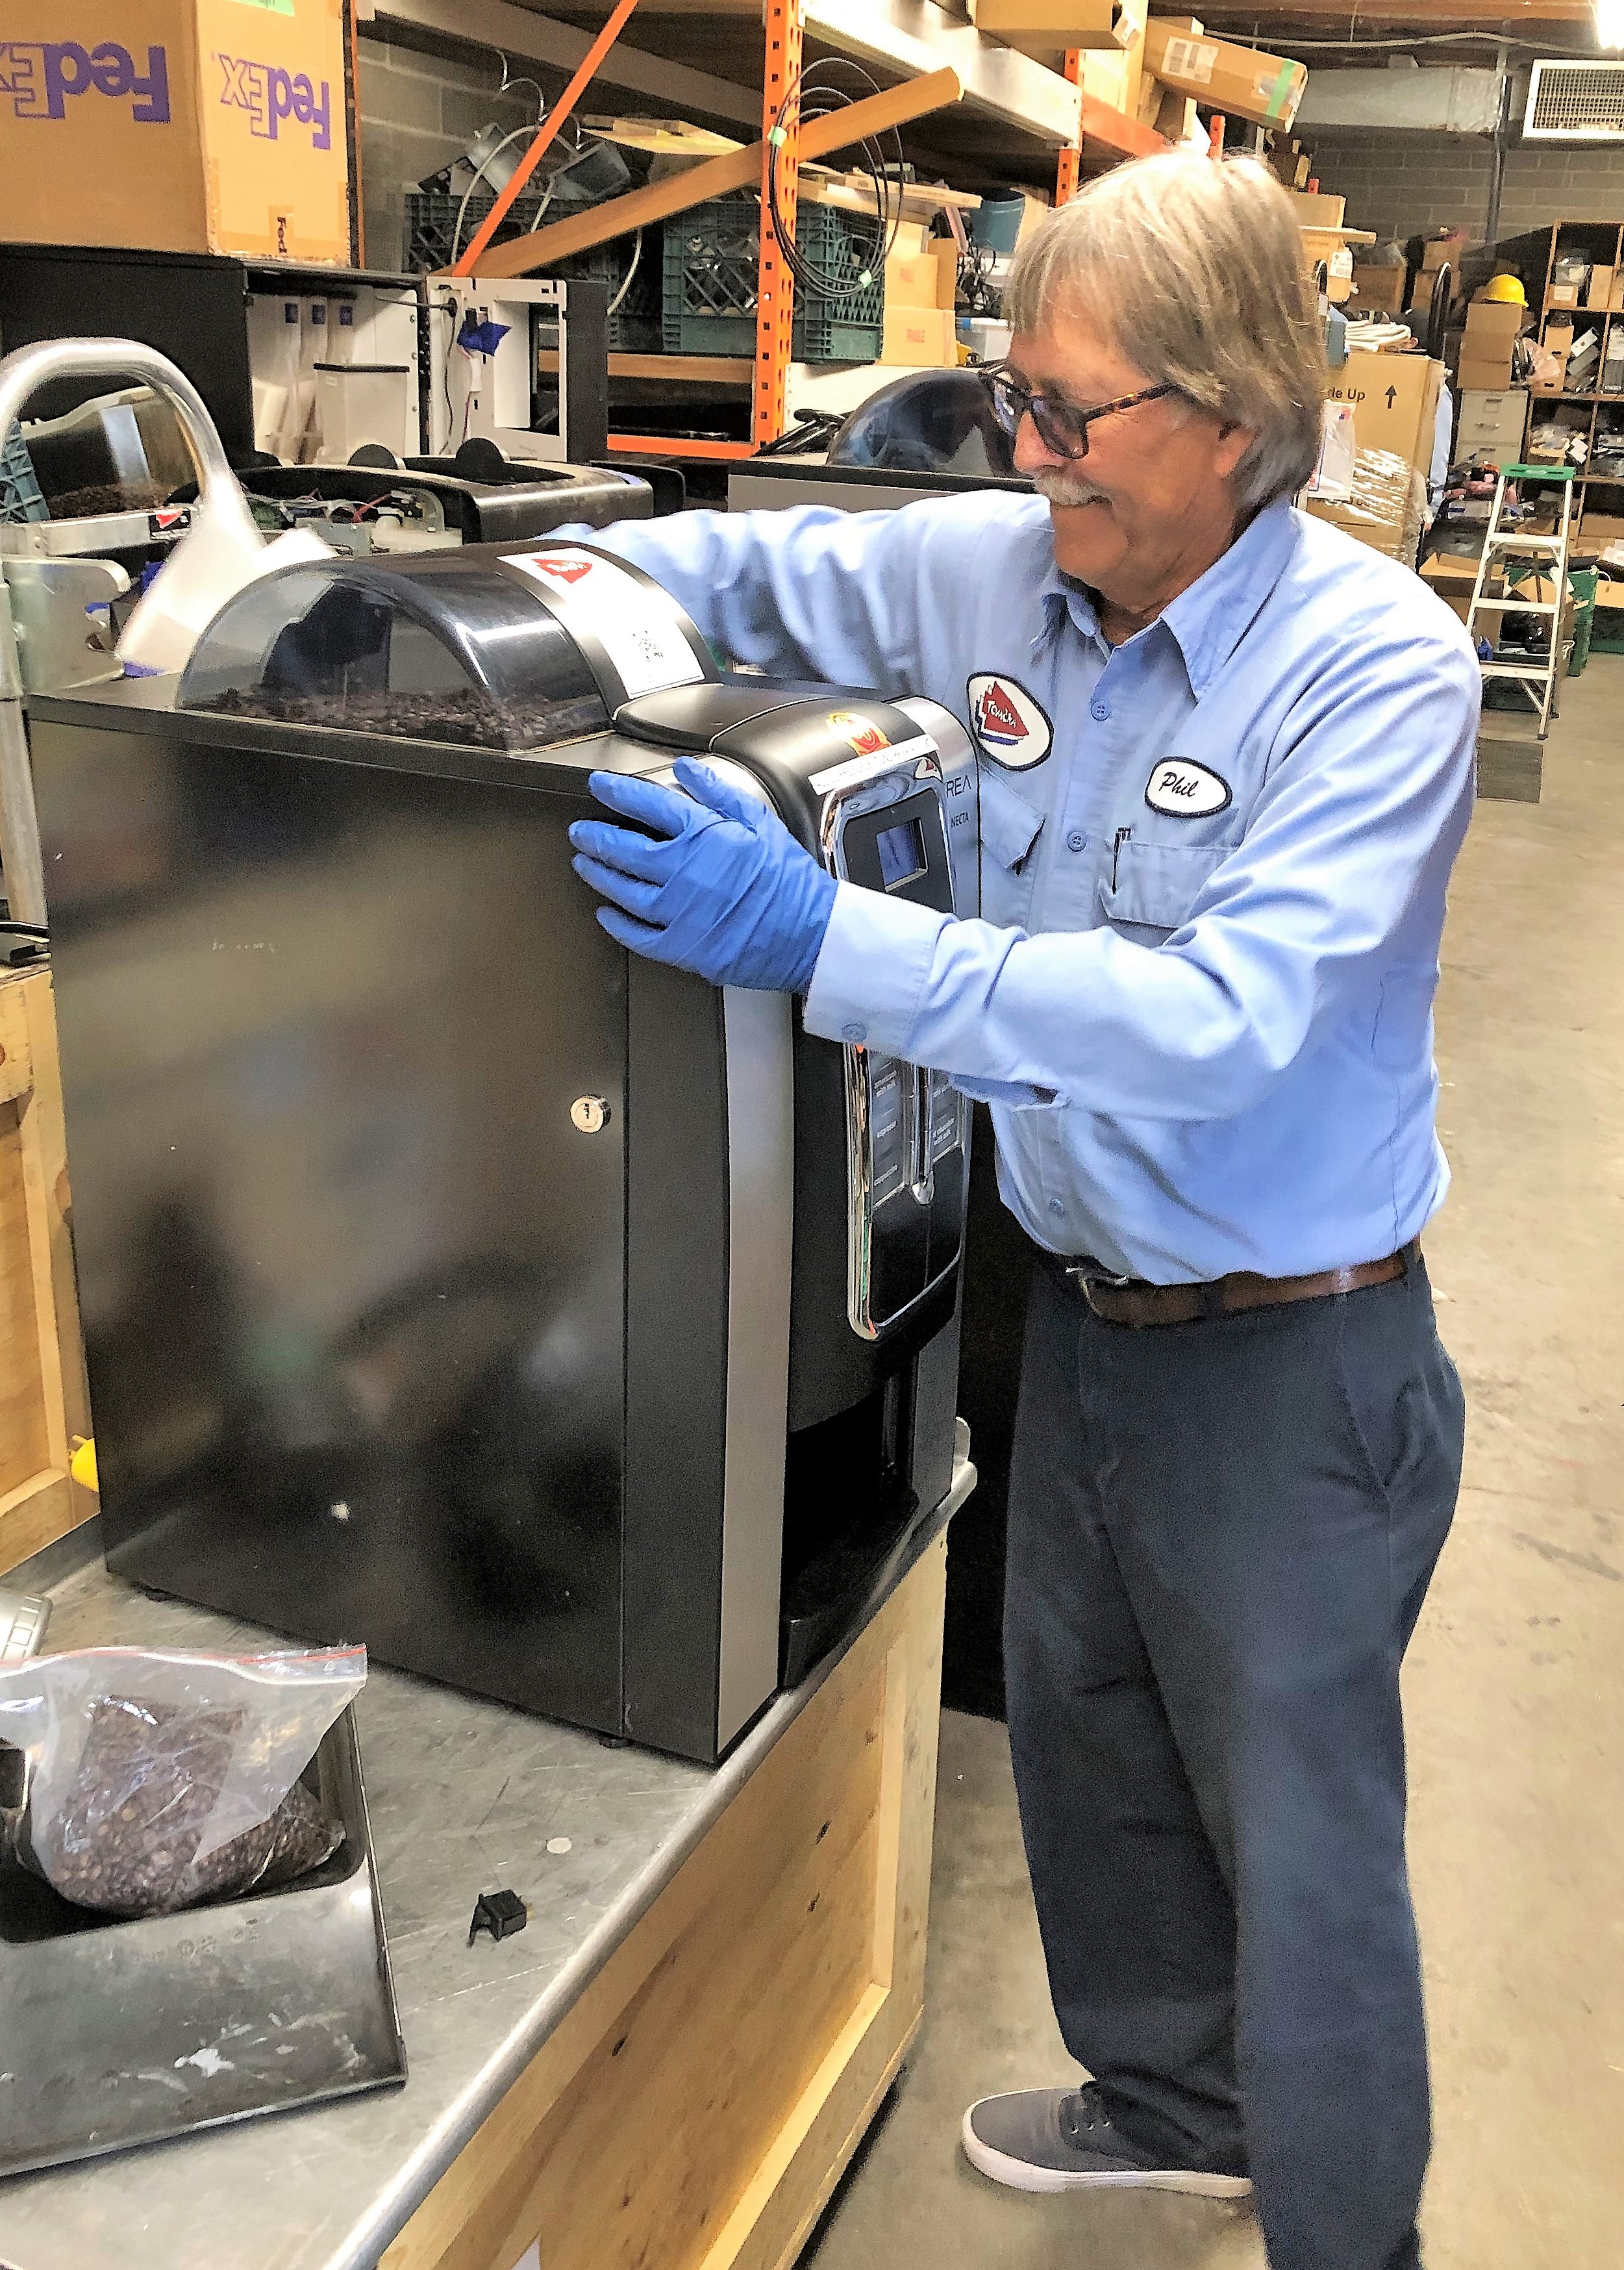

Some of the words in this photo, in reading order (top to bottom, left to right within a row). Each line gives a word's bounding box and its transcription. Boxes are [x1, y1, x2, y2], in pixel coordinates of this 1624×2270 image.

[218, 52, 330, 151] FedEx
[1347, 388, 1365, 402] Up
[1158, 772, 1199, 797] Phil
[951, 811, 969, 828] NECTA
